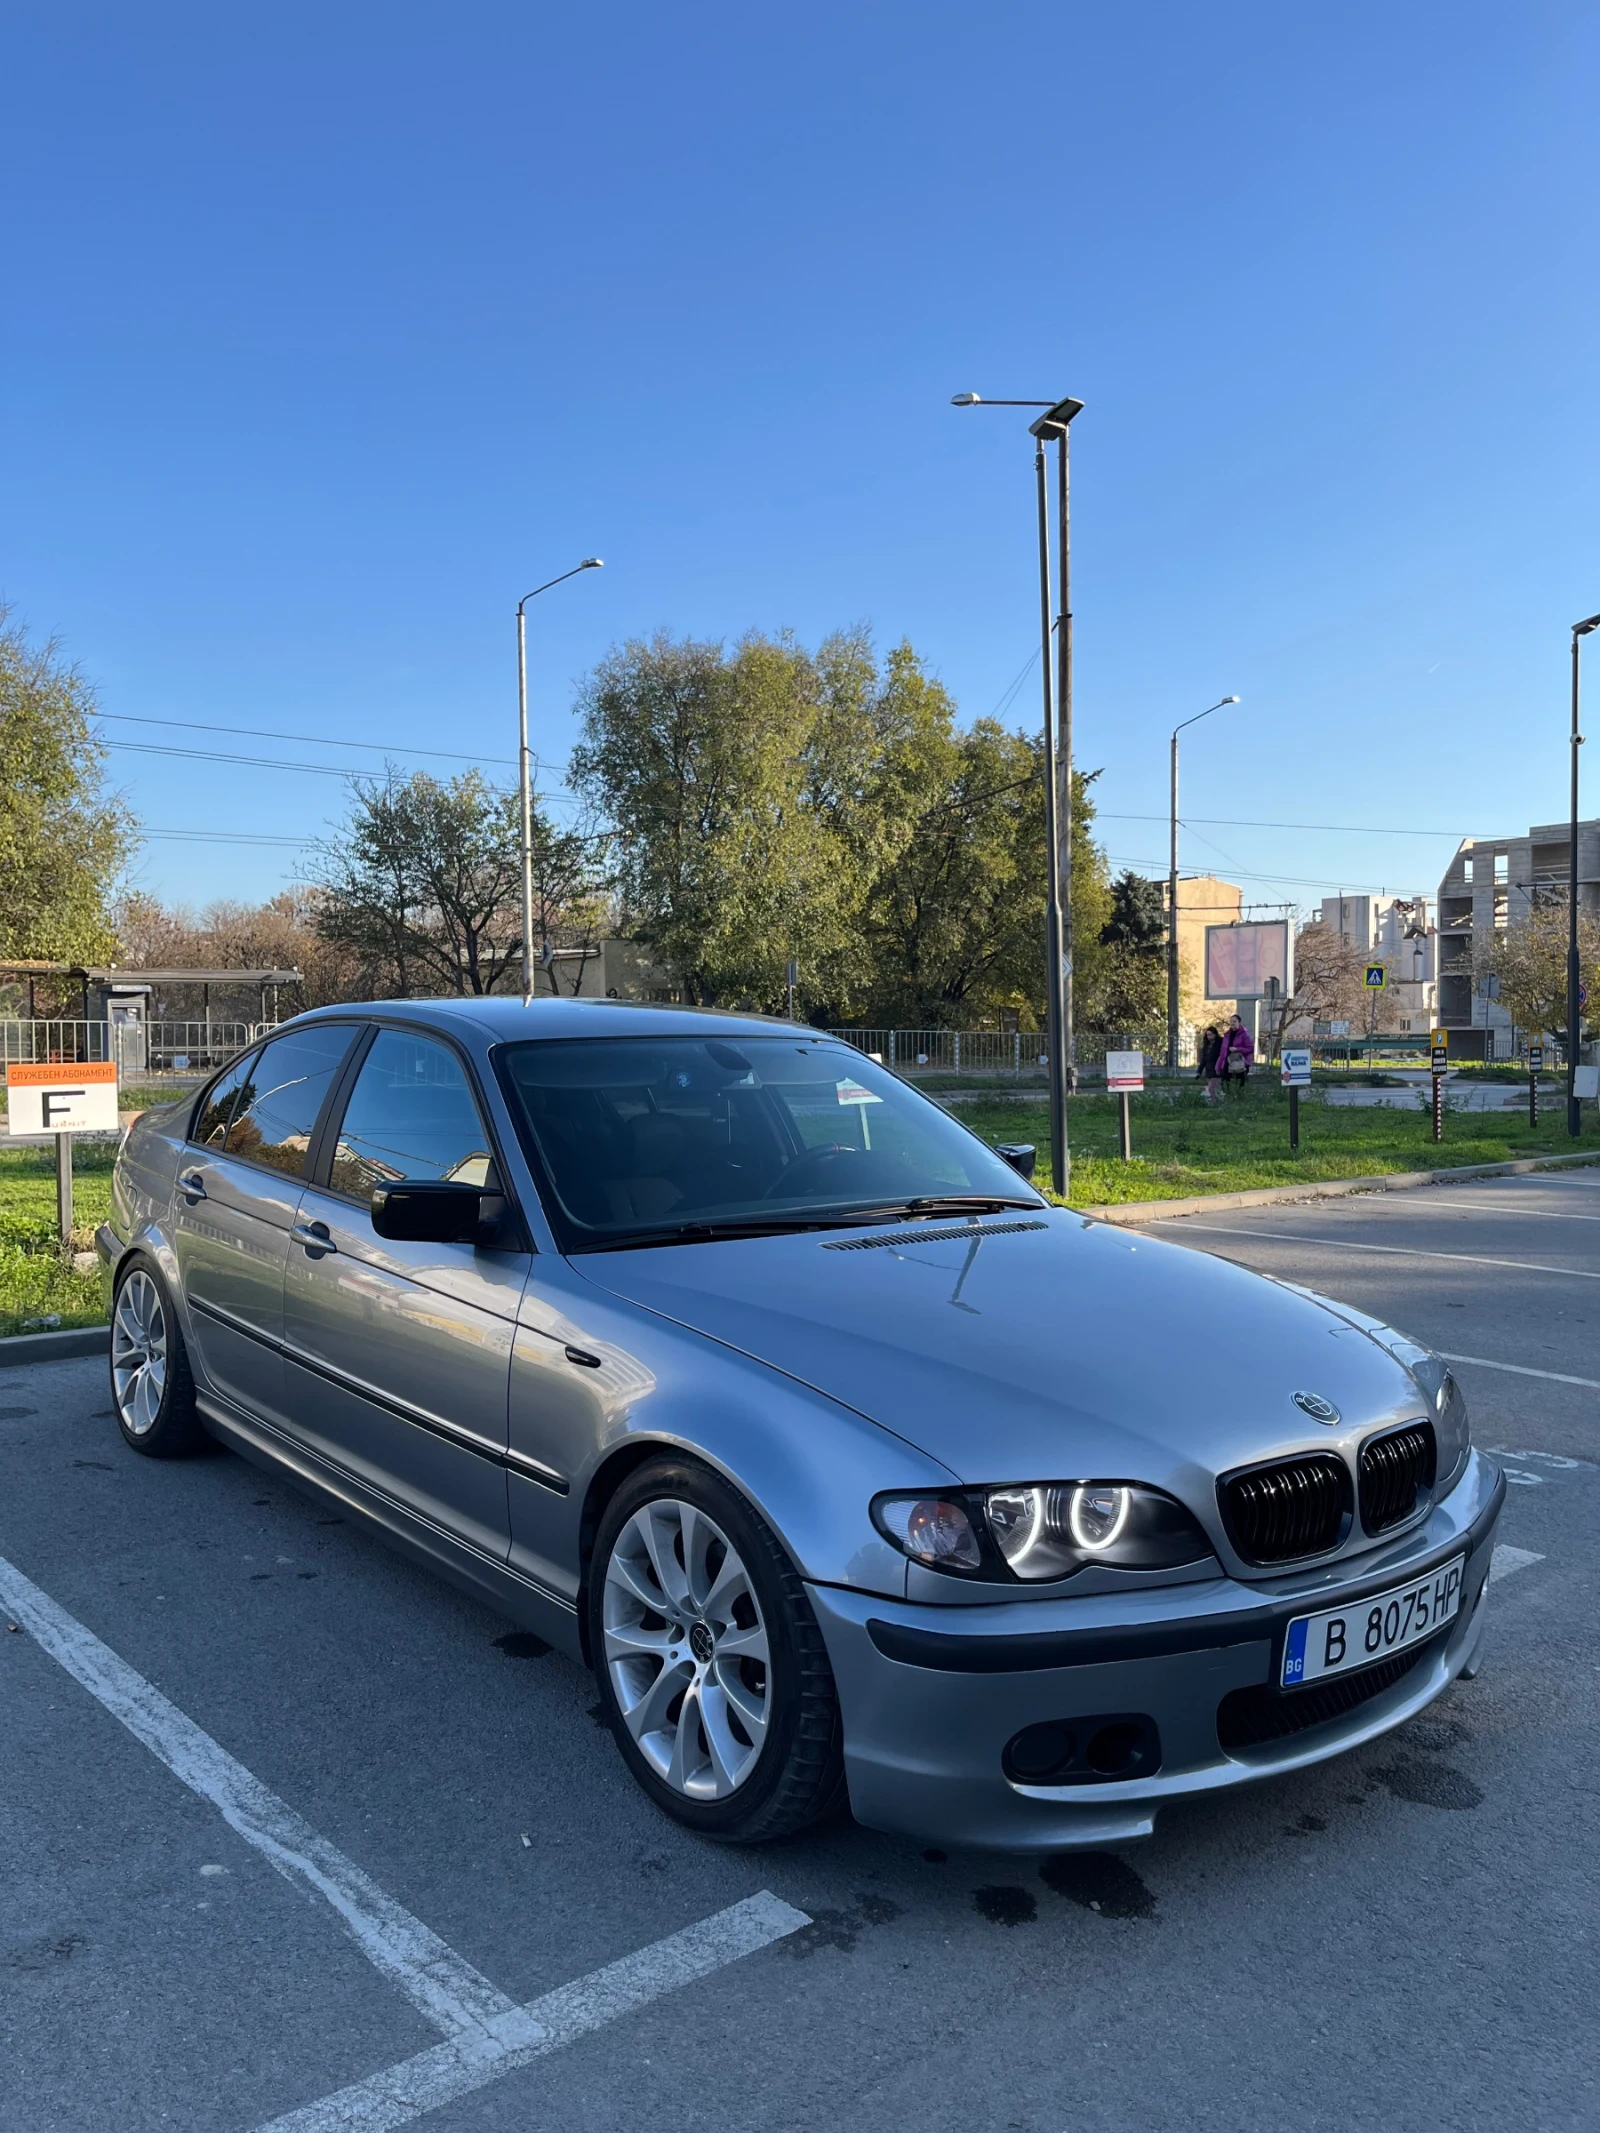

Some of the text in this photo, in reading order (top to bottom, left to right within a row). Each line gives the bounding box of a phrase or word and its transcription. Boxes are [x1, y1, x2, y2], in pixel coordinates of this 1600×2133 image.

[11, 1068, 113, 1081] СЛУЖЕБЕН АБОНАМЕНТ
[1324, 1567, 1460, 1667] B 8075 HP
[1286, 1659, 1302, 1675] BG
